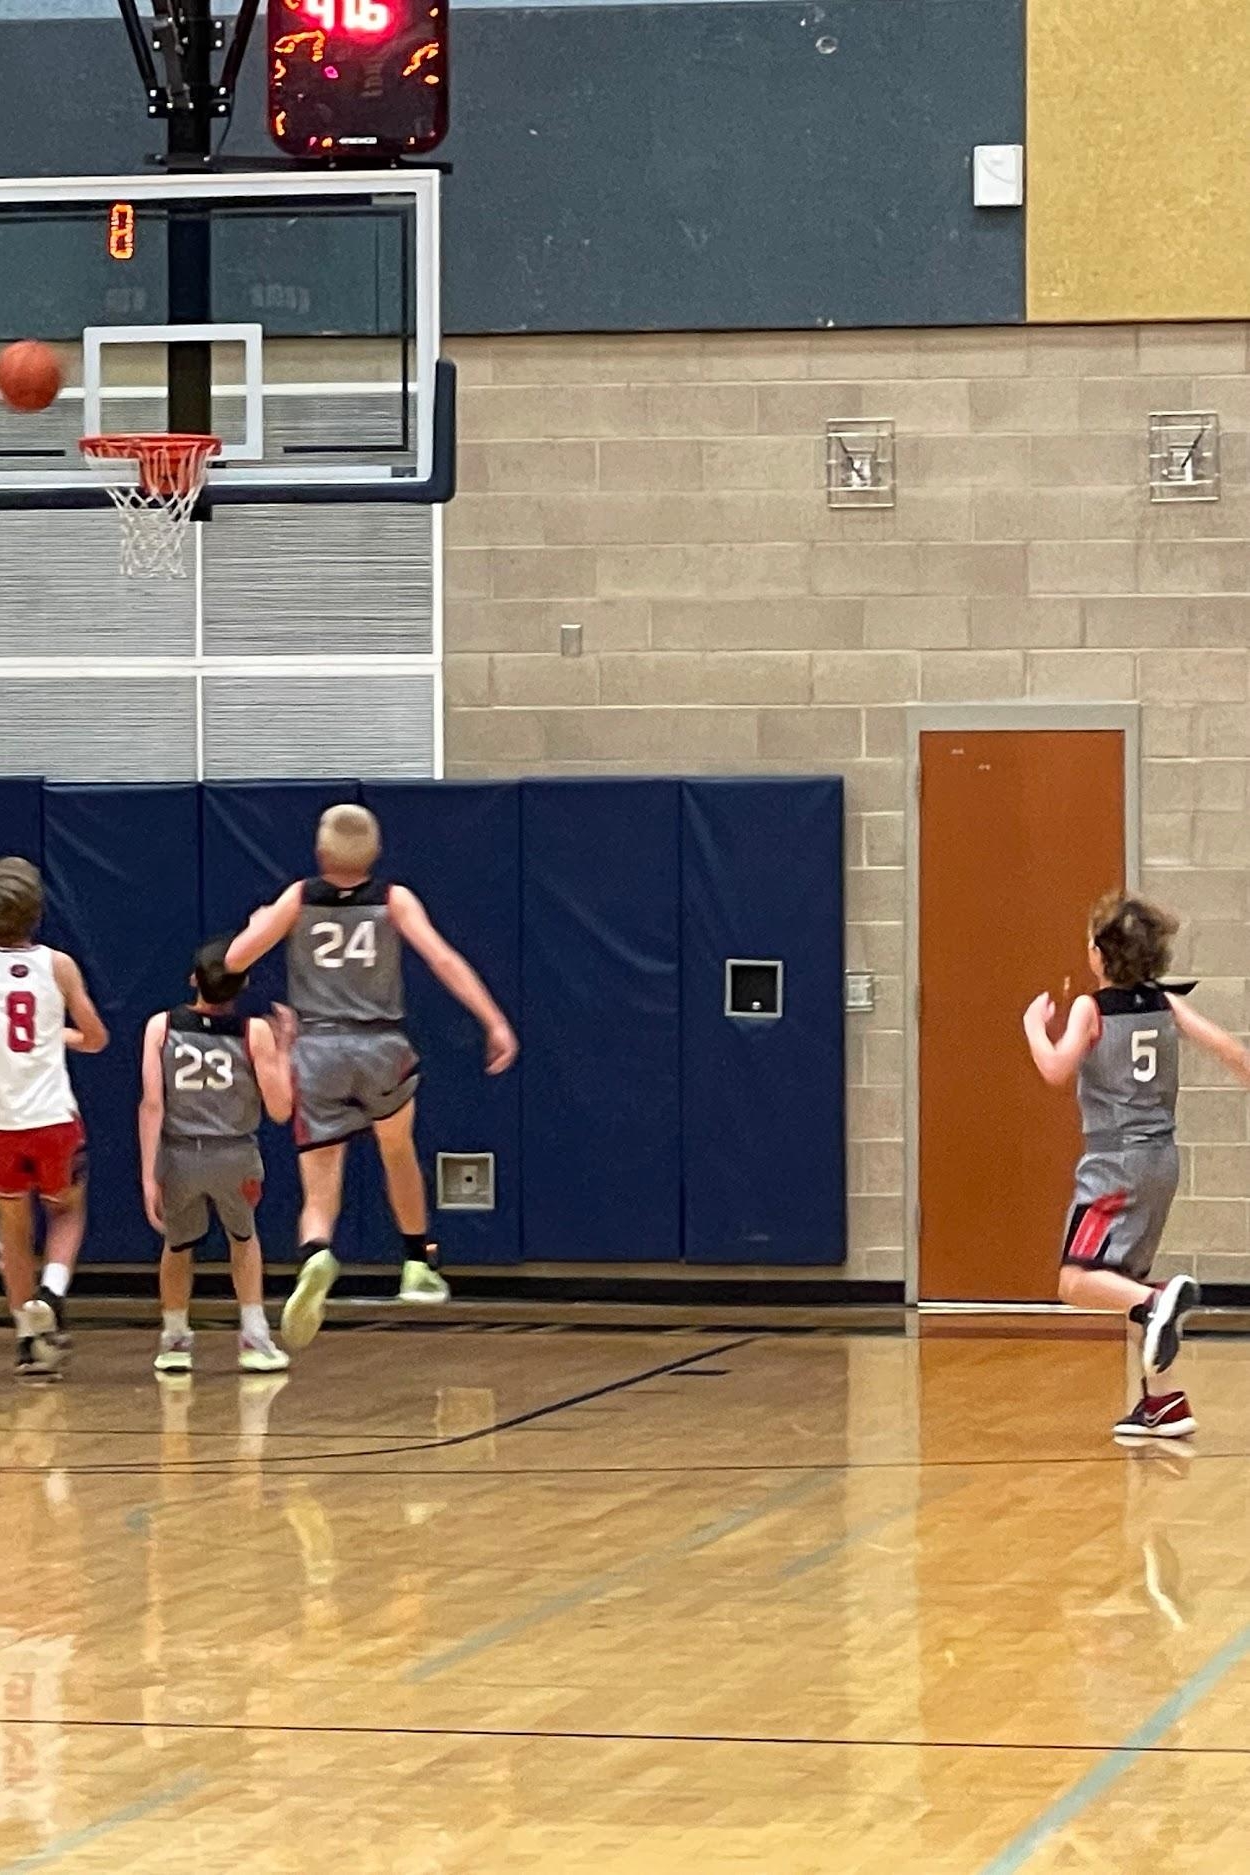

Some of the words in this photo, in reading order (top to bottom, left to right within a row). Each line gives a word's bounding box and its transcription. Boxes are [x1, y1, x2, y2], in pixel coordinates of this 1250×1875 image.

[310, 921, 378, 969] 24
[5, 991, 37, 1053] 8
[174, 1044, 234, 1090] 23
[1131, 1030, 1158, 1082] 5
